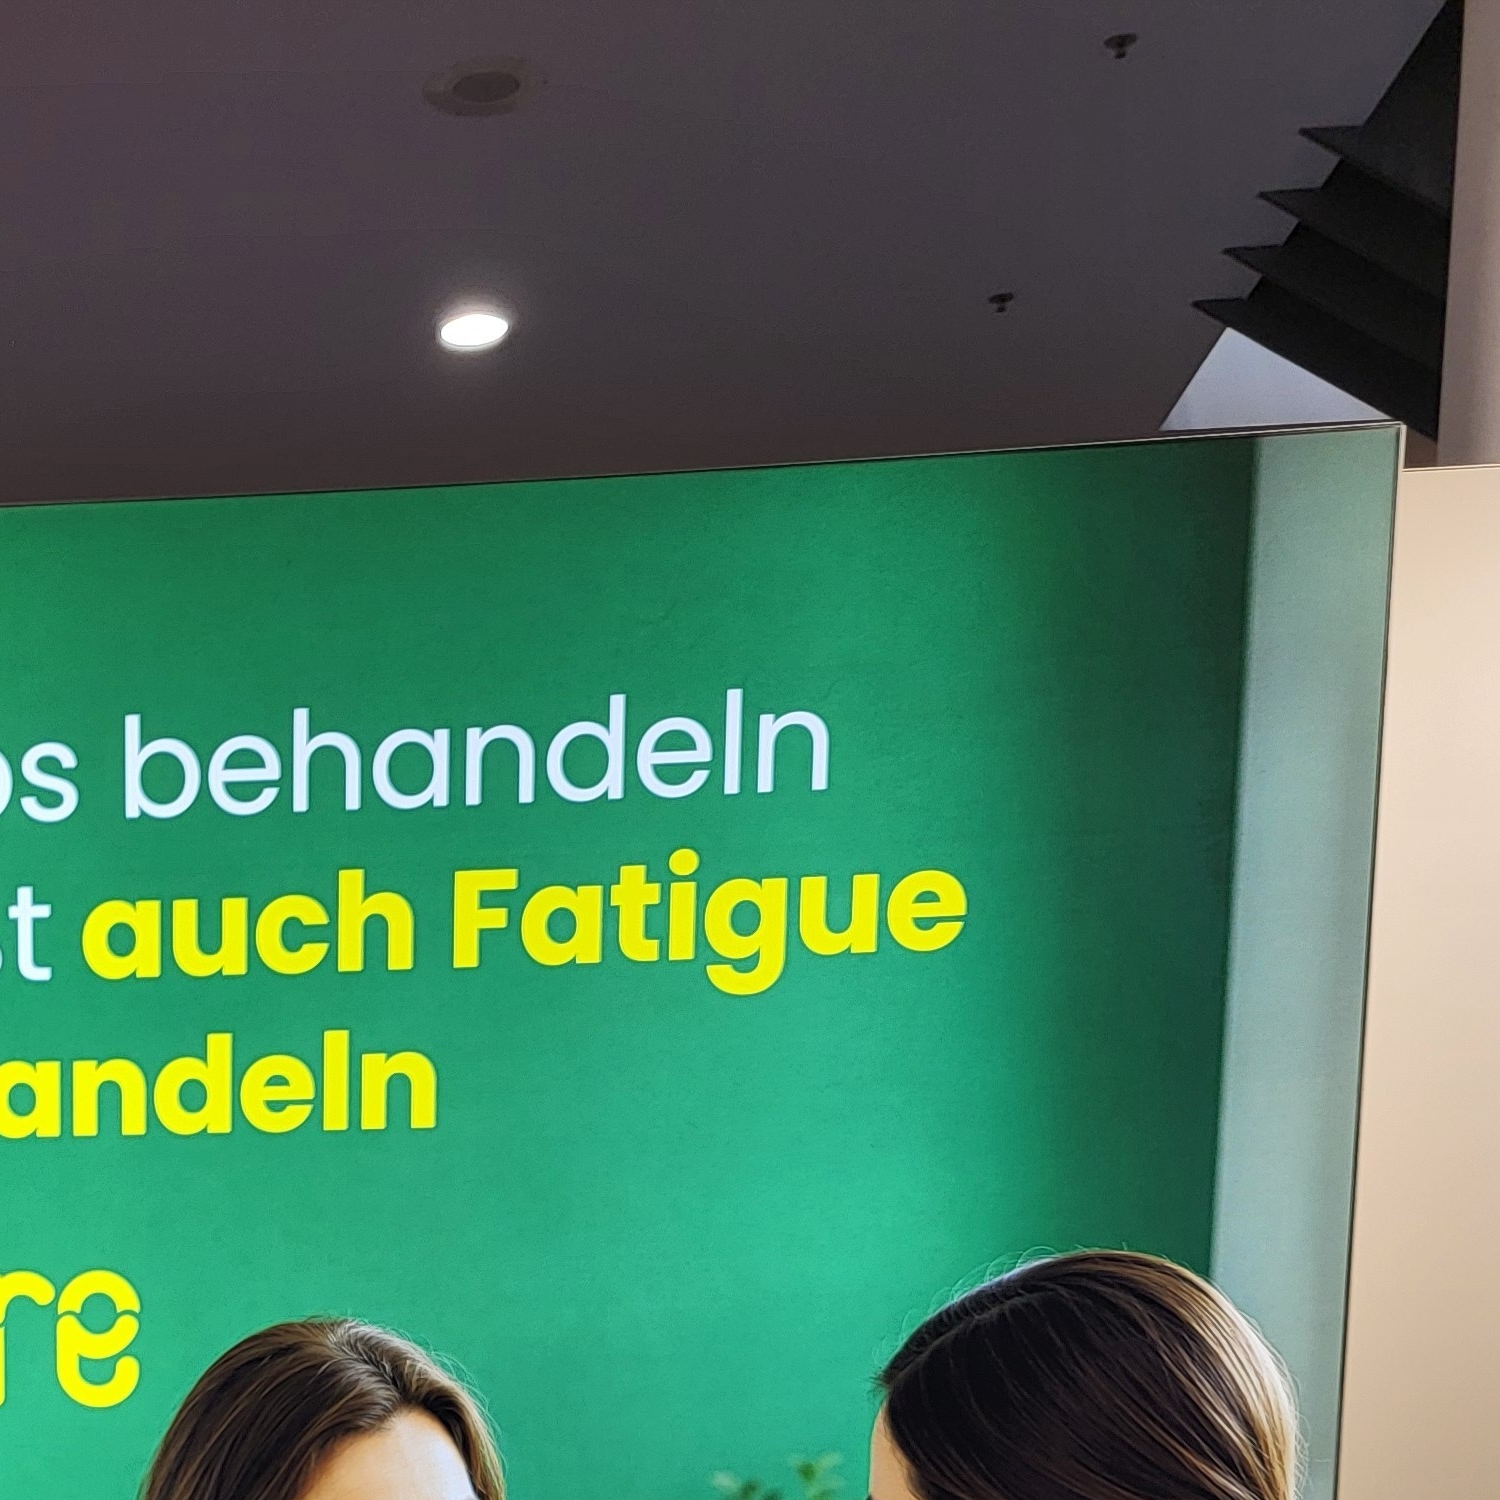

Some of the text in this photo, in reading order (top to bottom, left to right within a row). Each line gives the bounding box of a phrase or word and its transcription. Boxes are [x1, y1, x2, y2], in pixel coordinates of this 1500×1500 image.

[125, 688, 829, 818] behandeln
[82, 869, 414, 980] auch
[453, 848, 967, 996] Fatigue
